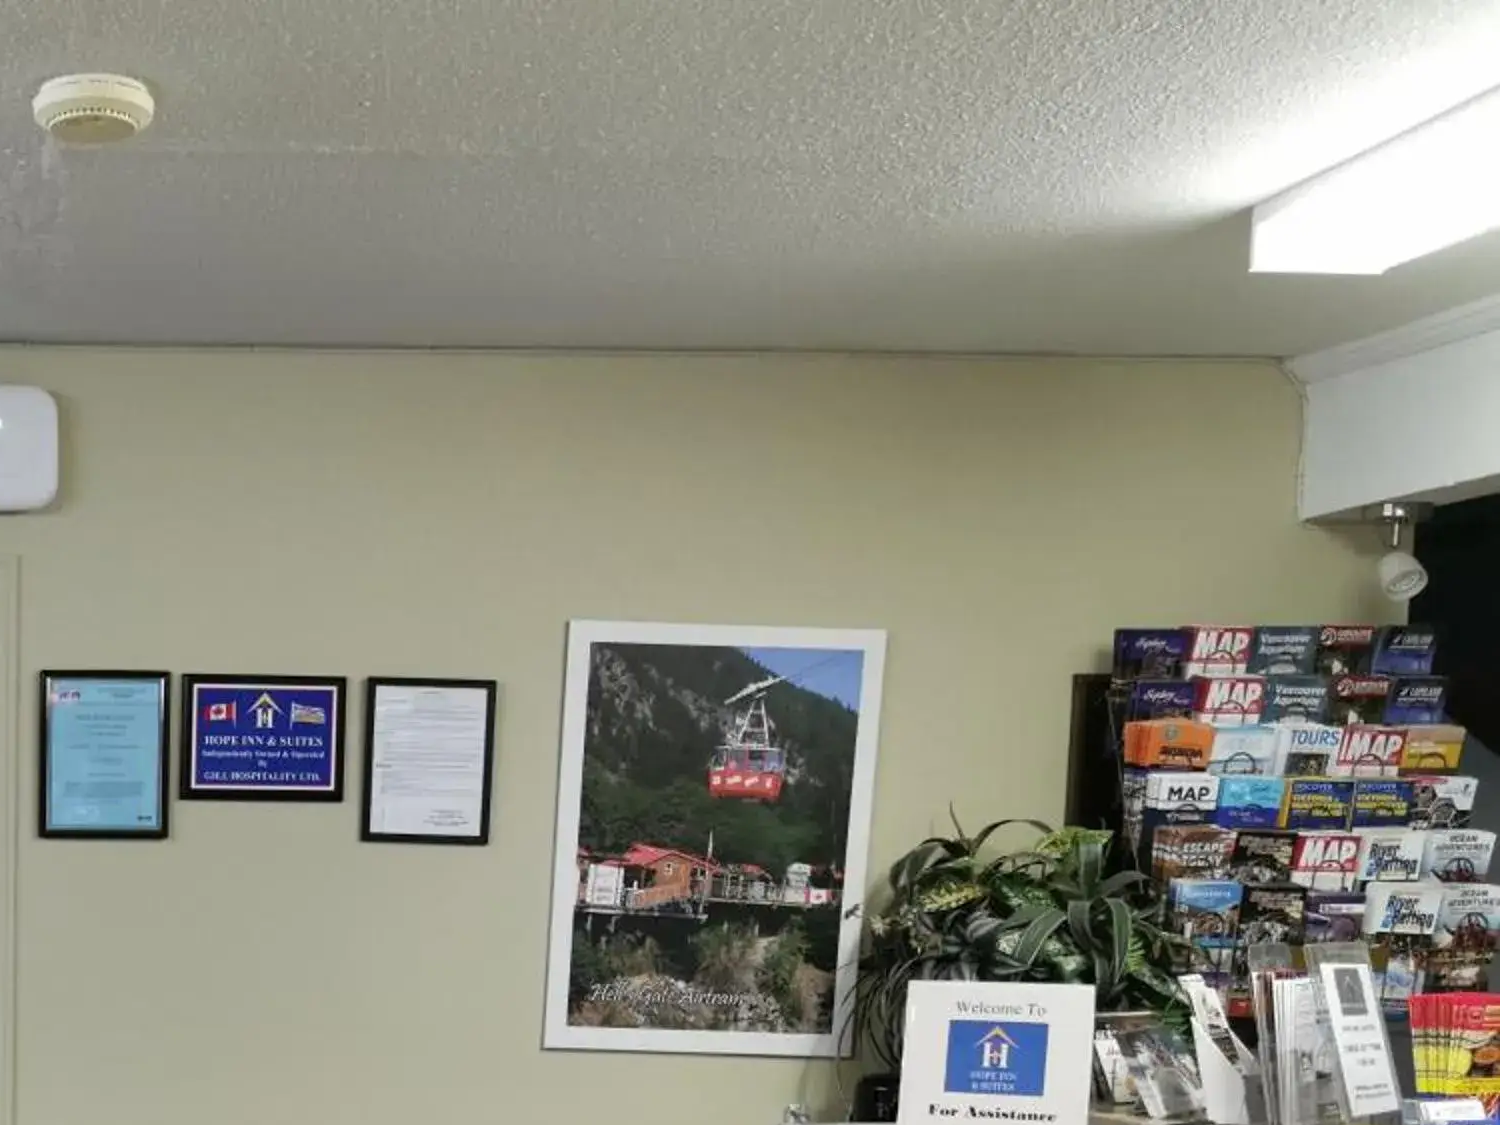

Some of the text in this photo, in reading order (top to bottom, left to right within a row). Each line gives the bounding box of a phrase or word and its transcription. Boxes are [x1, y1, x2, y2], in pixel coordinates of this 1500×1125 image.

[1192, 630, 1250, 661] MAP
[1204, 680, 1262, 710] MAP
[204, 736, 323, 747] HOPE INN & SUITES
[1291, 729, 1340, 746] TOURS
[231, 772, 296, 780] HOSPITALITY
[1168, 786, 1210, 801] MAP
[1301, 836, 1357, 868] MAP
[956, 1000, 1047, 1017] Welcome To
[929, 1103, 1057, 1122] For Assistance
